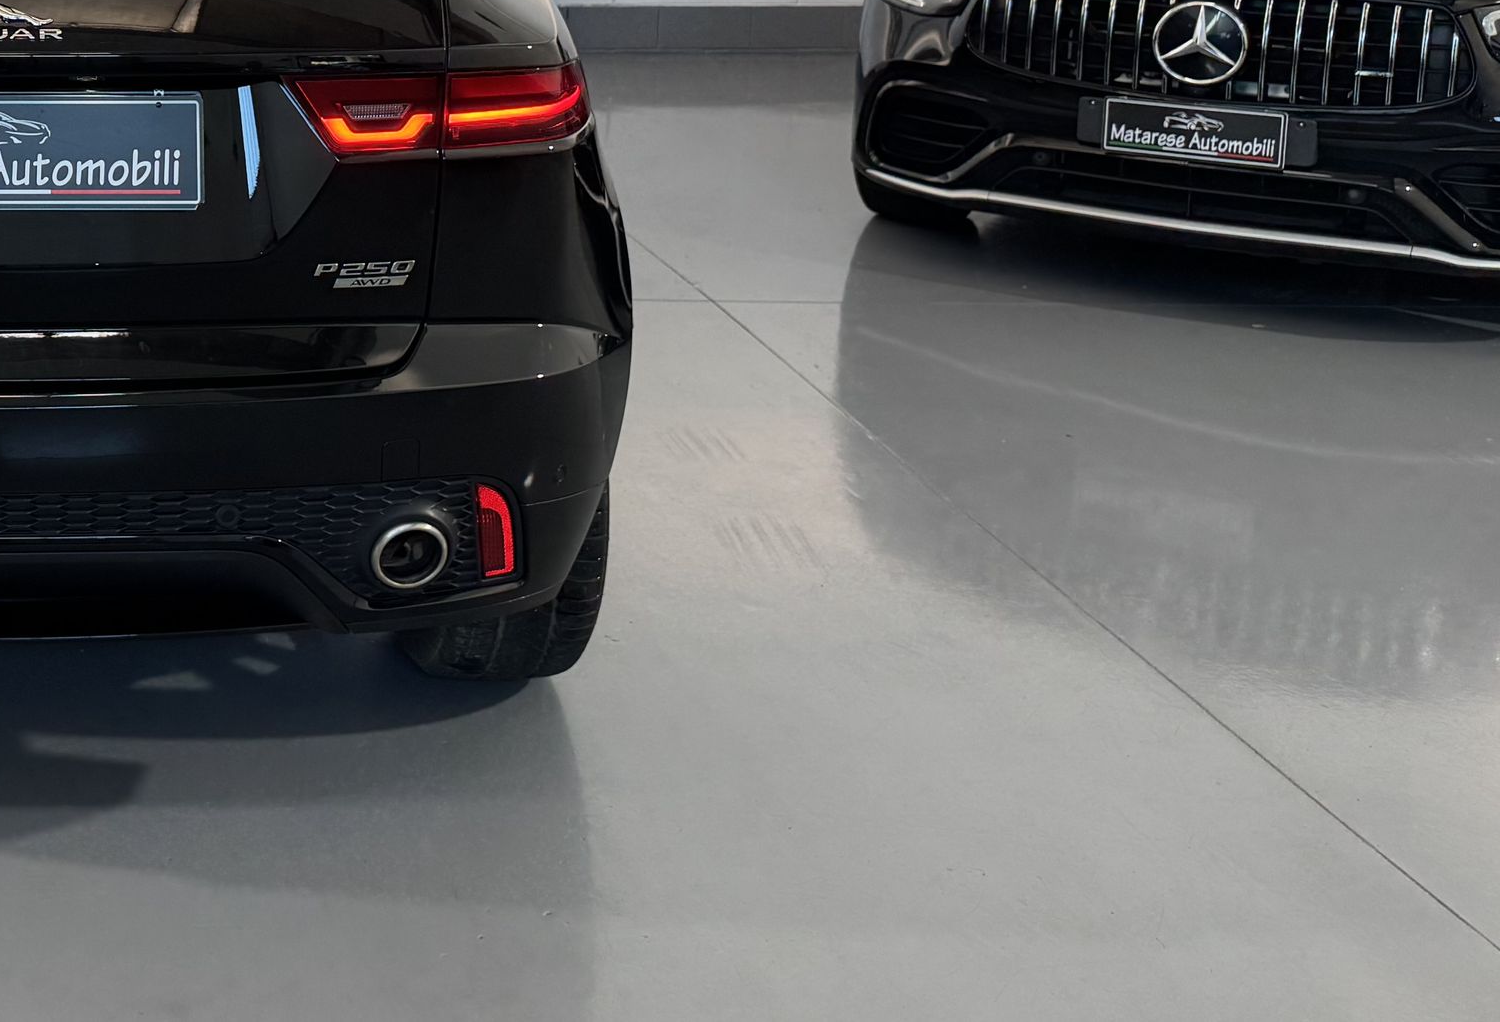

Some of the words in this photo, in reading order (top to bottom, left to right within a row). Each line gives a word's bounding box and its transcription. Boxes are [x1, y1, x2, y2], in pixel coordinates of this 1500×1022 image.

[1110, 123, 1186, 148] Matarese
[1189, 130, 1275, 157] Automobili
[314, 260, 416, 276] P250
[351, 278, 392, 286] AWD
